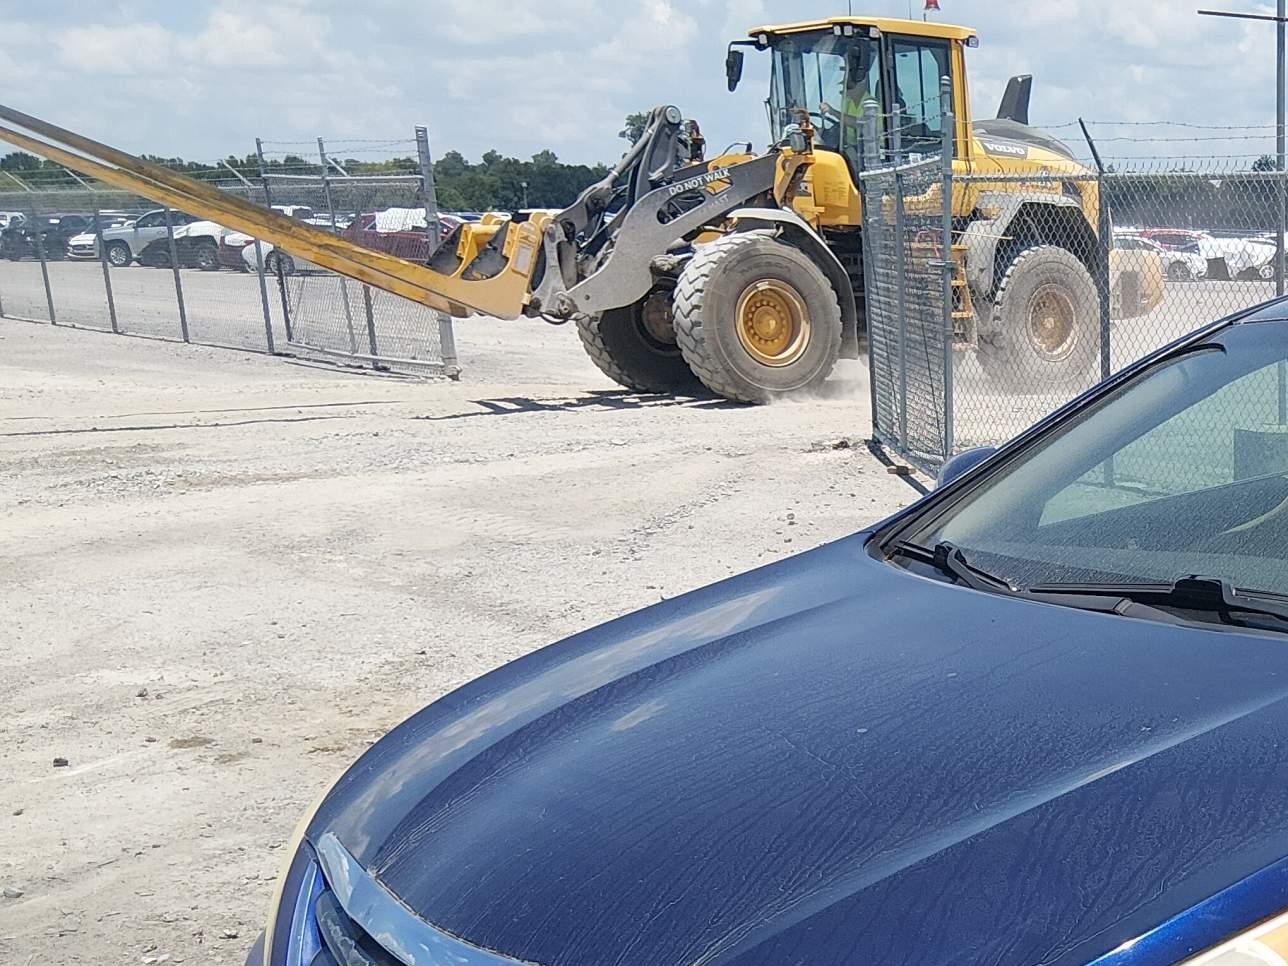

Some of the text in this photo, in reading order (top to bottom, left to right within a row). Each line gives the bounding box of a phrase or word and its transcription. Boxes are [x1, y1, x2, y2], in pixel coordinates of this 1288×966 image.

[983, 142, 1026, 155] VOLVO
[668, 167, 731, 196] DO NOT WALK
